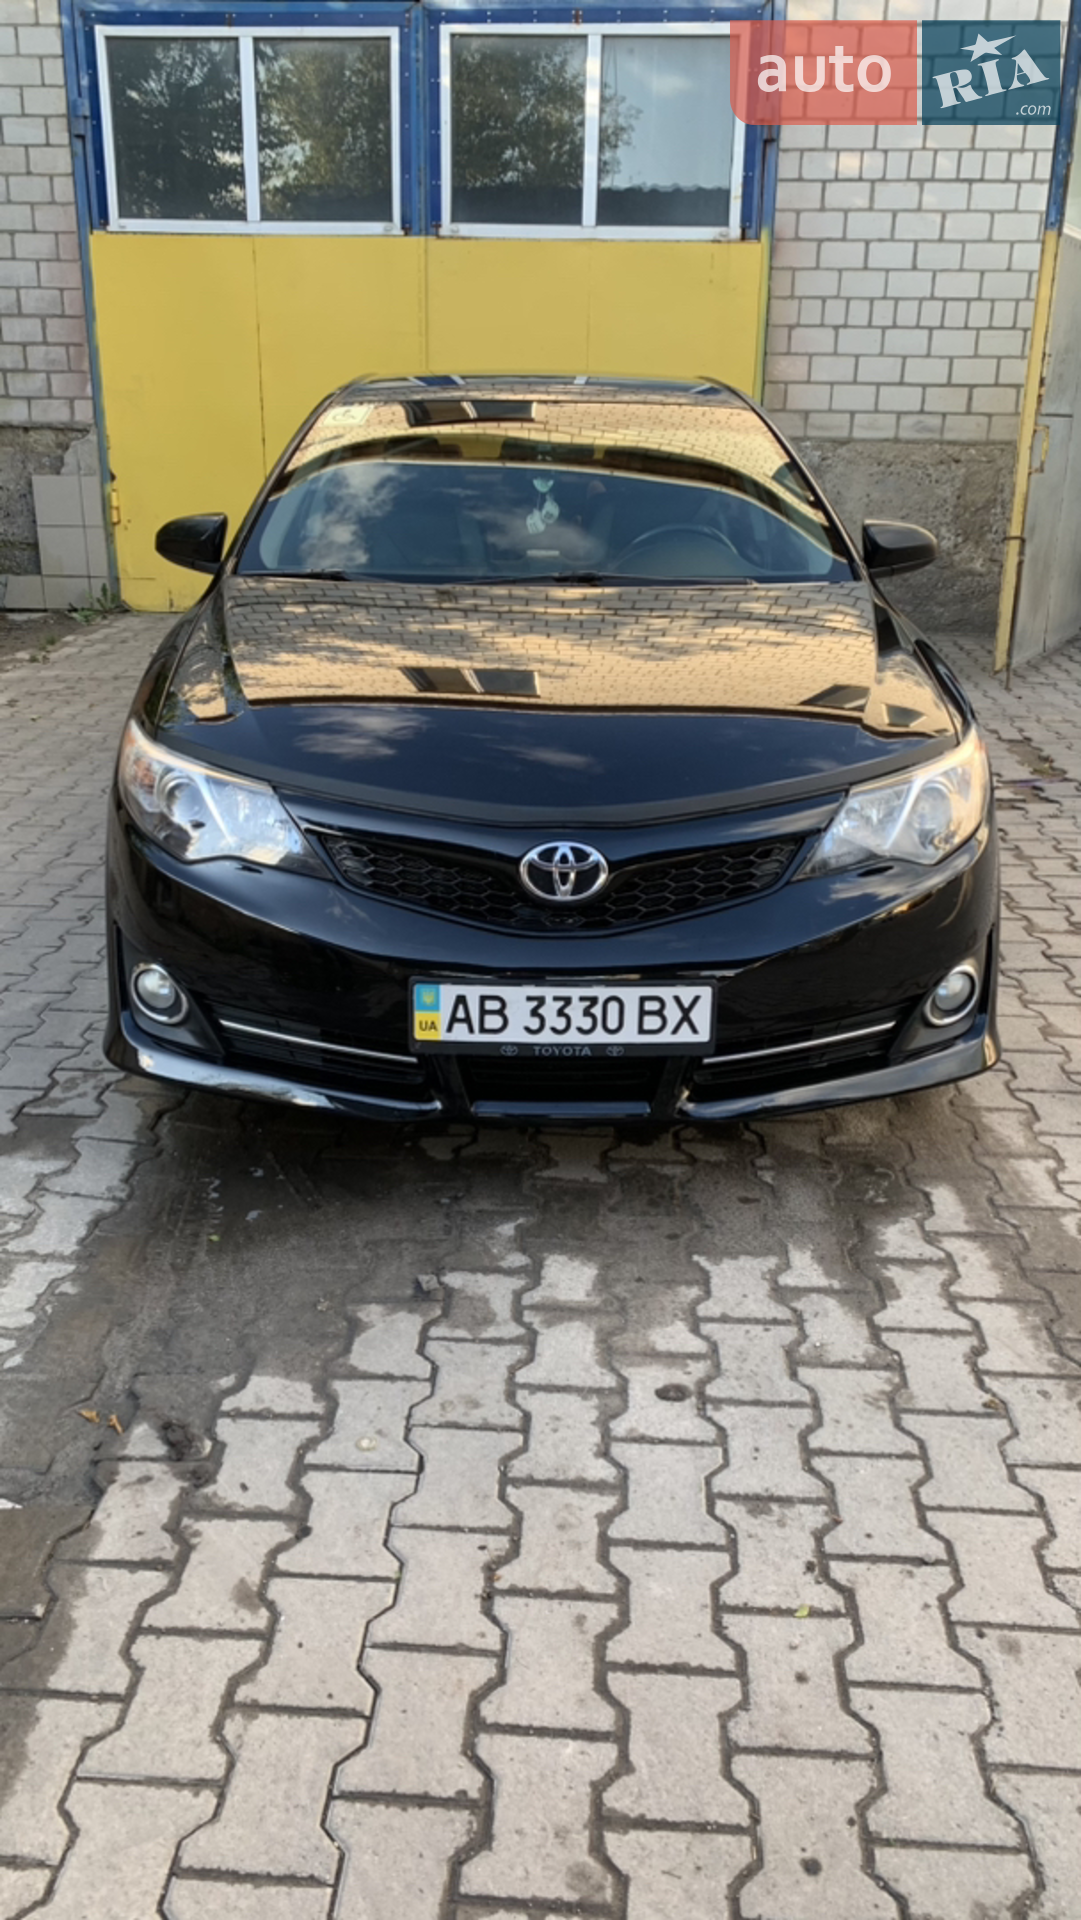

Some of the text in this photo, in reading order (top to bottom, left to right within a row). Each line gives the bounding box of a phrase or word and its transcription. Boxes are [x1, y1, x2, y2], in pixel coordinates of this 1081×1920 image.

[446, 994, 702, 1035] AB 3330 BX
[419, 1020, 438, 1032] UA
[533, 1046, 592, 1056] TOYOTA
